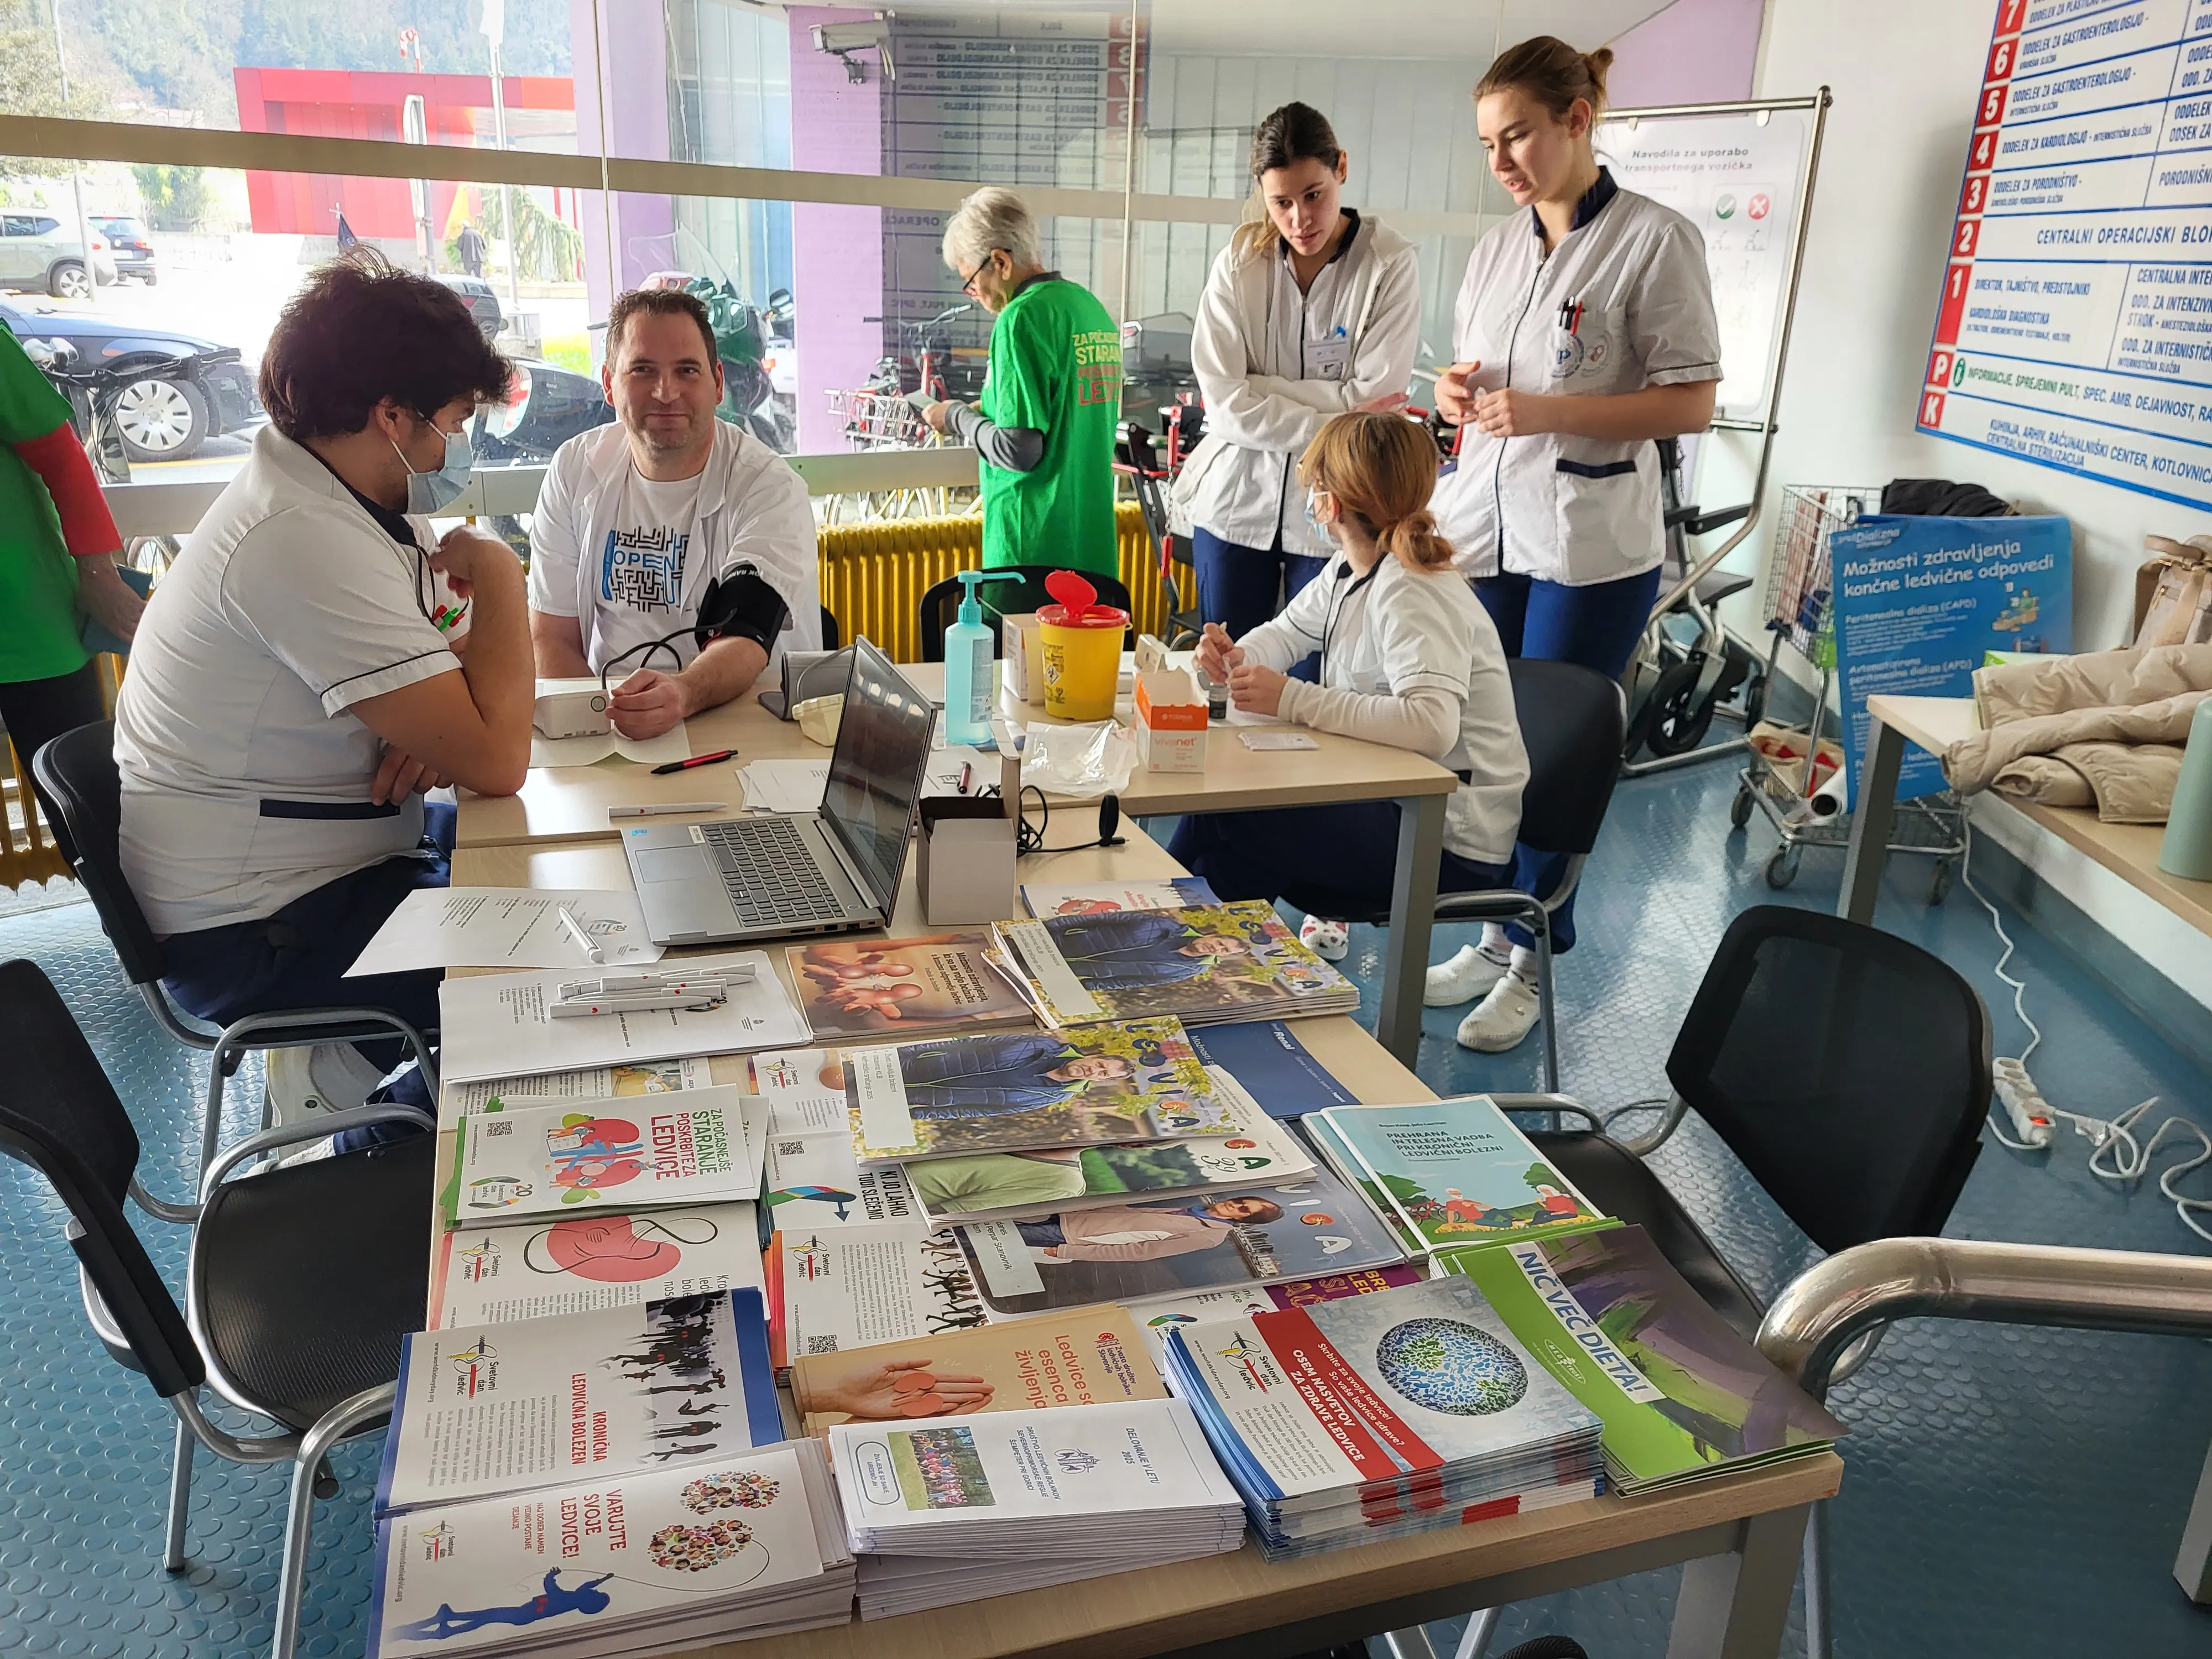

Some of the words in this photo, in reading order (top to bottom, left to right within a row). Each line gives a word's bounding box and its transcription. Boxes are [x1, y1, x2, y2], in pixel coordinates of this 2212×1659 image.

[2004, 0, 2020, 28] 7
[1994, 44, 2010, 76] 6
[1984, 88, 2001, 121] 5
[1632, 149, 1679, 159] Navodila
[1700, 147, 1749, 159] uporabo
[1976, 142, 1990, 165] 4
[1968, 179, 1982, 208] 3
[1958, 223, 1974, 254] 2
[2037, 229, 2093, 244] CENTRALNI
[2098, 227, 2176, 244] OPERACIJSKI
[1952, 270, 1963, 299] 1
[1933, 354, 1948, 383] P
[2135, 395, 2195, 422] DEJAVNOST,
[1923, 396, 1939, 426] K
[2110, 445, 2148, 470] CENTER,
[1843, 551, 1918, 577] Možnosti
[1923, 539, 2021, 566] zdravljenja
[1844, 577, 1901, 598] končne
[1905, 568, 1974, 589] ledvične
[1978, 554, 2054, 580] odpovedi
[1191, 1035, 1213, 1061] Možnosti
[1274, 1031, 1296, 1051] Renal
[710, 1108, 723, 1120] ZA
[651, 1114, 680, 1180] LEDVICE
[676, 1112, 695, 1164] POSKRBITE
[692, 1110, 718, 1175] STARANJE
[712, 1121, 734, 1172] POČASNEJŠE
[1416, 1141, 1475, 1150] KRONIČNI
[1457, 1145, 1504, 1155] BOLEZNI
[682, 1165, 697, 1177] ZA
[858, 1172, 876, 1188] TUDI
[879, 1170, 899, 1179] KI
[515, 1184, 533, 1197] 20
[862, 1189, 884, 1220] SLEČEMO
[885, 1191, 909, 1217] LAHKO
[491, 1255, 502, 1277] Svetovni
[798, 1261, 807, 1278] ledvic
[822, 1253, 832, 1276] Svetovni
[993, 1241, 1013, 1271] Stanovnik
[463, 1264, 474, 1280] ledvic
[481, 1267, 491, 1278] dan
[813, 1266, 823, 1277] dan
[1516, 1252, 1562, 1289] NIČ
[1546, 1290, 1594, 1330] VEČ
[1575, 1332, 1650, 1392] DIETA!
[427, 1342, 440, 1404] www.worldkidneyday.org
[487, 1361, 499, 1391] Svetovni
[1038, 1350, 1069, 1402] esenca
[1055, 1335, 1087, 1390] Ledvice
[1098, 1349, 1113, 1374] Slovenije
[1105, 1348, 1122, 1372] ledvičnih
[1117, 1373, 1133, 1396] bolnikov
[1115, 1345, 1127, 1363] Zveza
[1123, 1364, 1137, 1384] društev
[1194, 1339, 1231, 1400] www.worldkidneyday.org
[1259, 1355, 1285, 1385] Svetovni
[456, 1374, 468, 1396] ledvic
[476, 1379, 487, 1392] dan
[1014, 1350, 1048, 1408] življenja
[1238, 1369, 1256, 1390] ledvic
[1260, 1373, 1273, 1387] dan
[1292, 1349, 1317, 1376] OSEM
[1310, 1377, 1356, 1427] NASVETOV
[1317, 1343, 1341, 1368] Skrbite
[1338, 1367, 1349, 1376] za
[1346, 1376, 1364, 1394] svoje
[1363, 1393, 1394, 1421] ledvice!
[572, 1373, 589, 1420] LEDVIČNA
[1328, 1371, 1339, 1381] So
[1338, 1380, 1354, 1396] vaše
[1351, 1396, 1376, 1421] ledvice
[1374, 1420, 1405, 1446] zdrave?
[1290, 1370, 1306, 1385] ZA
[1300, 1384, 1334, 1422] ZDRAVE
[1327, 1421, 1365, 1462] LEDVICE
[571, 1421, 587, 1465] BOLEZEN
[592, 1411, 611, 1463] KRONIČNA
[1009, 1439, 1024, 1465] ŠEMPETER
[1016, 1430, 1042, 1480] SEVERNOPRIMORSKE
[1026, 1426, 1040, 1449] DRUŠTVO
[1035, 1450, 1051, 1475] LEDVIČNIH
[1045, 1475, 1061, 1500] BOLNIKOV
[1121, 1451, 1135, 1464] 2025
[1125, 1428, 1150, 1463] DELOVANJE
[1145, 1469, 1161, 1484] LETU
[1018, 1465, 1028, 1474] PRI
[1022, 1474, 1035, 1491] GORICI
[511, 1506, 520, 1530] DEJANJE
[523, 1504, 532, 1522] VEDNO
[536, 1514, 545, 1532] DOBER
[560, 1496, 580, 1558] LEDVICE!
[583, 1493, 602, 1536] SVOJE
[606, 1489, 627, 1551] VARUJTE
[447, 1535, 456, 1557] Svetovni
[524, 1523, 533, 1550] POSTANE
[536, 1533, 545, 1554] NAMEN
